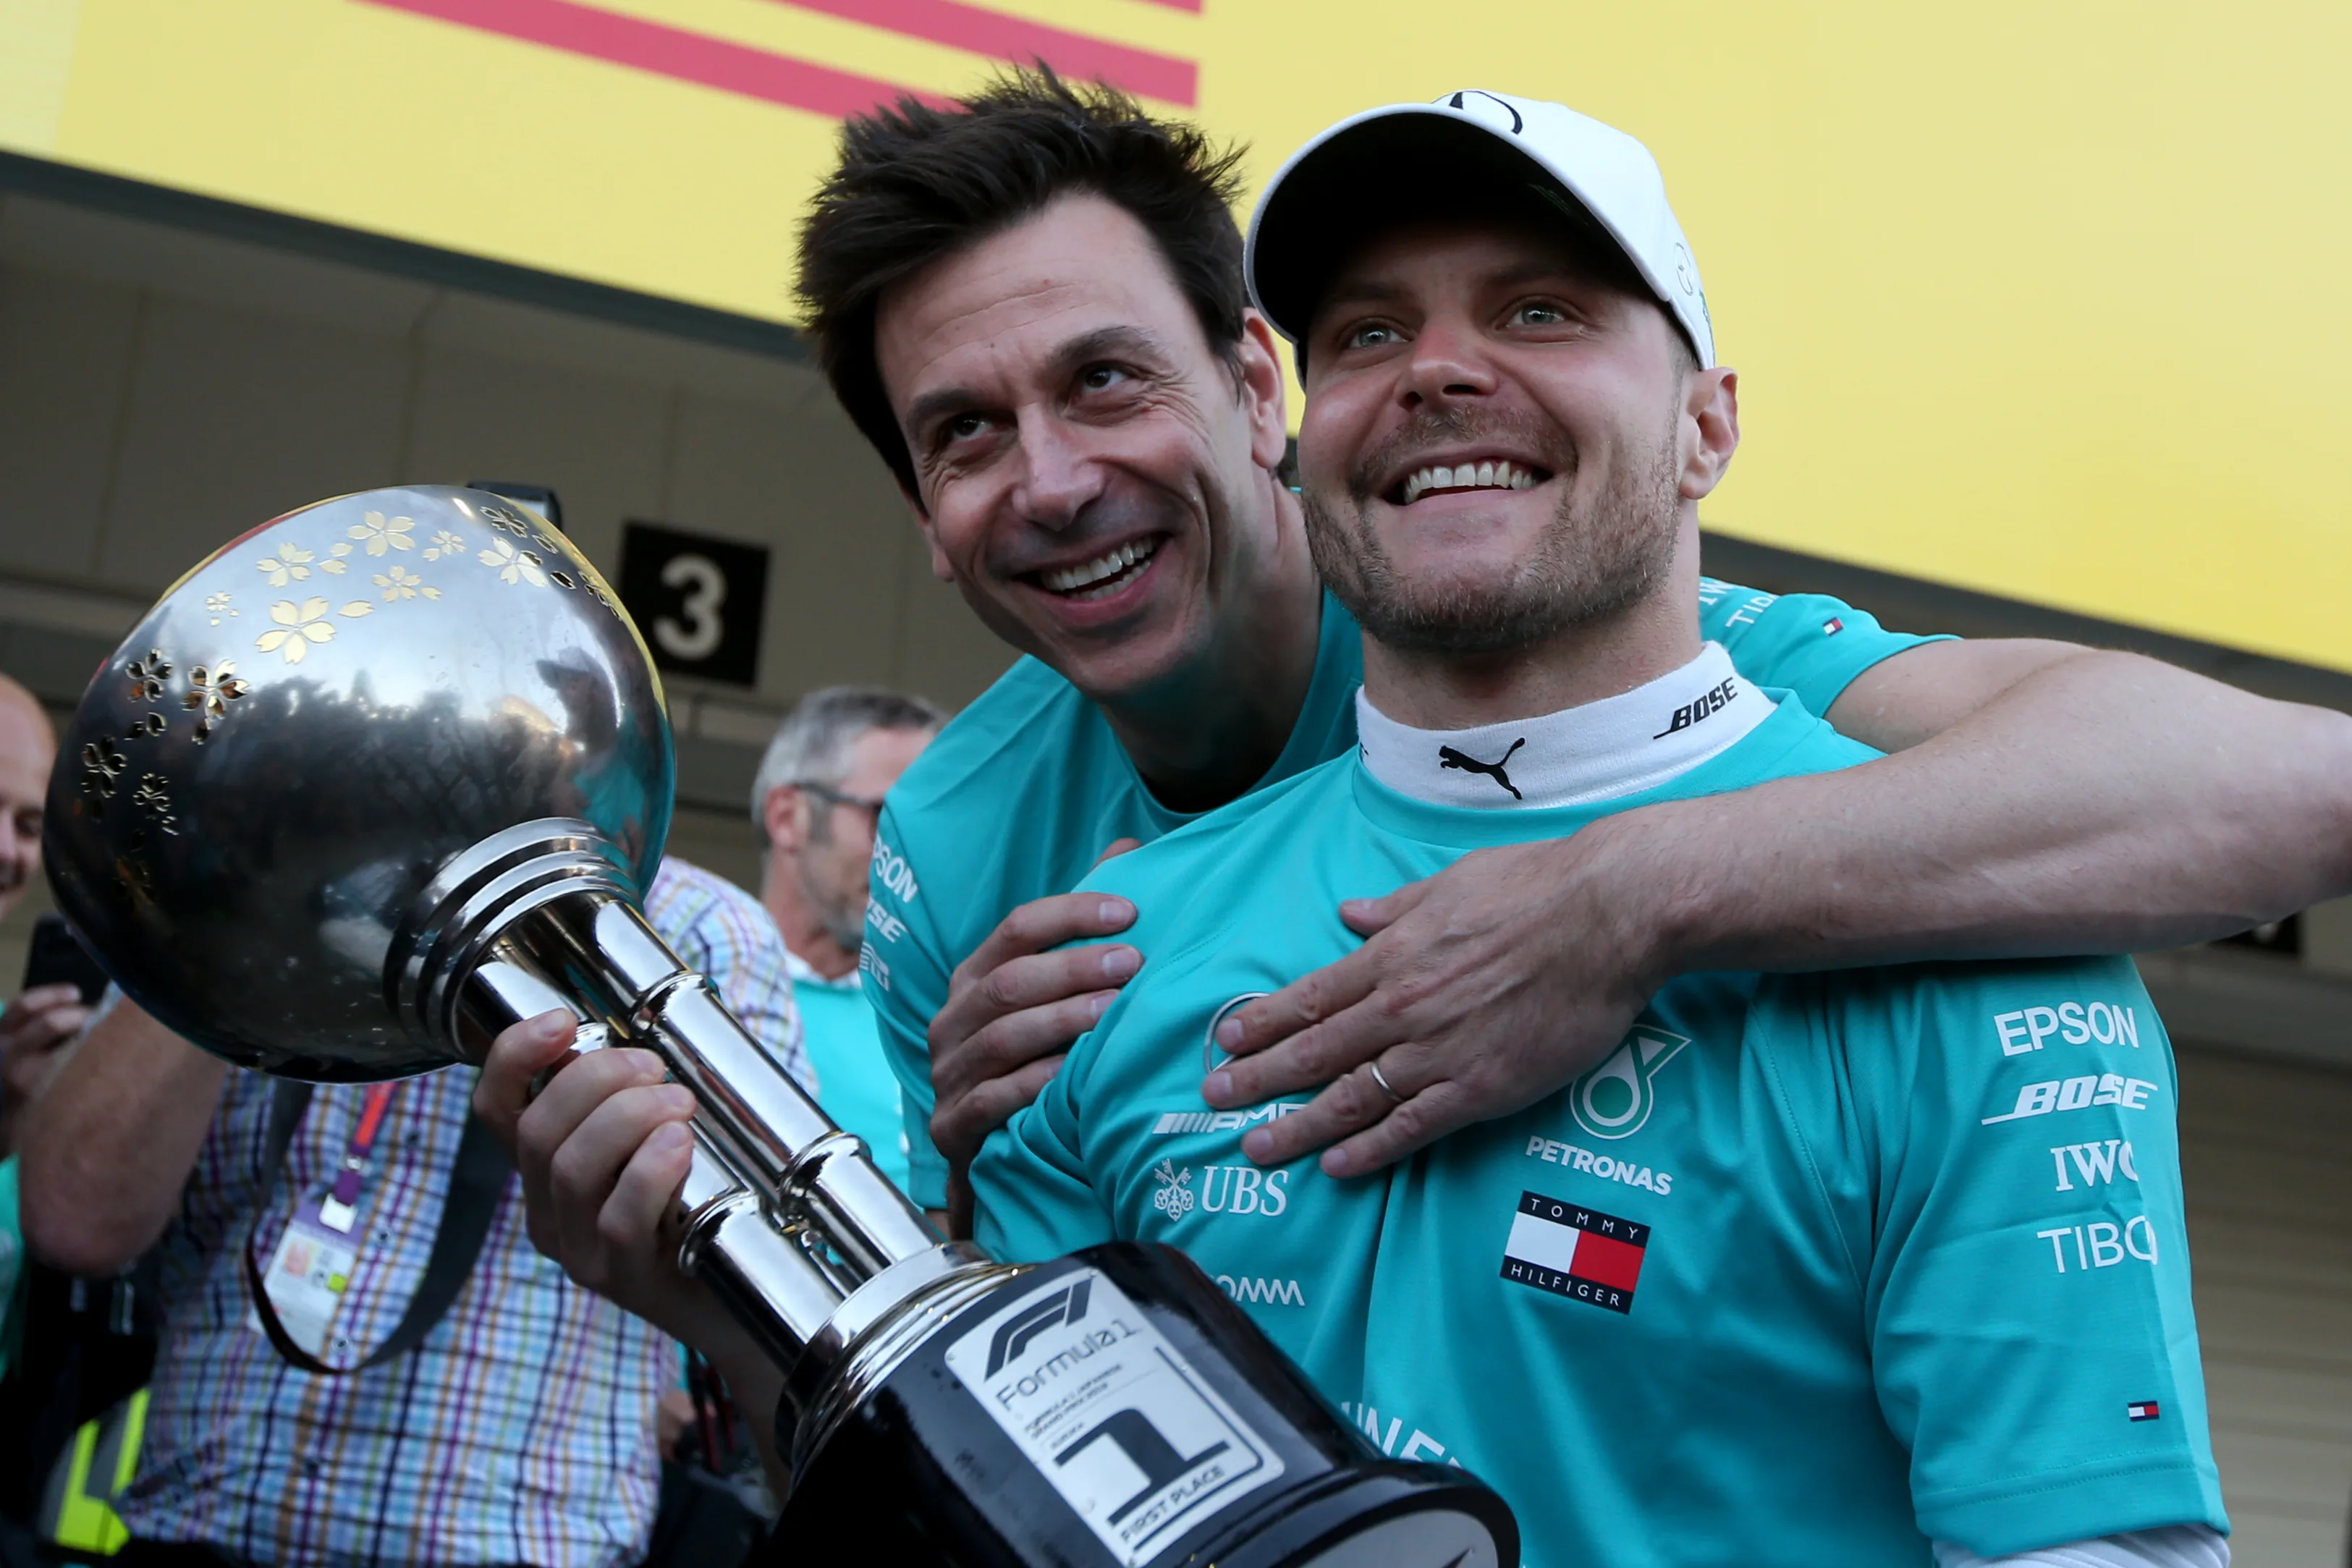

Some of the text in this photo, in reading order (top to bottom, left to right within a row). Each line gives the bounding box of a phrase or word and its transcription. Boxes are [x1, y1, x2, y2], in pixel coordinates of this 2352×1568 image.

[654, 553, 724, 661] 3
[1653, 677, 1738, 739] BOSE
[1994, 1001, 2139, 1056] EPSON
[1981, 1072, 2158, 1125] BOSE
[1201, 1166, 1289, 1216] UBS
[1526, 1135, 1673, 1196] PETRONAS
[1531, 1198, 1638, 1239] TOMMY
[1511, 1264, 1620, 1306] HILFIGER
[1053, 1408, 1232, 1527] 1
[1120, 1465, 1225, 1543] FIRST PLACE
